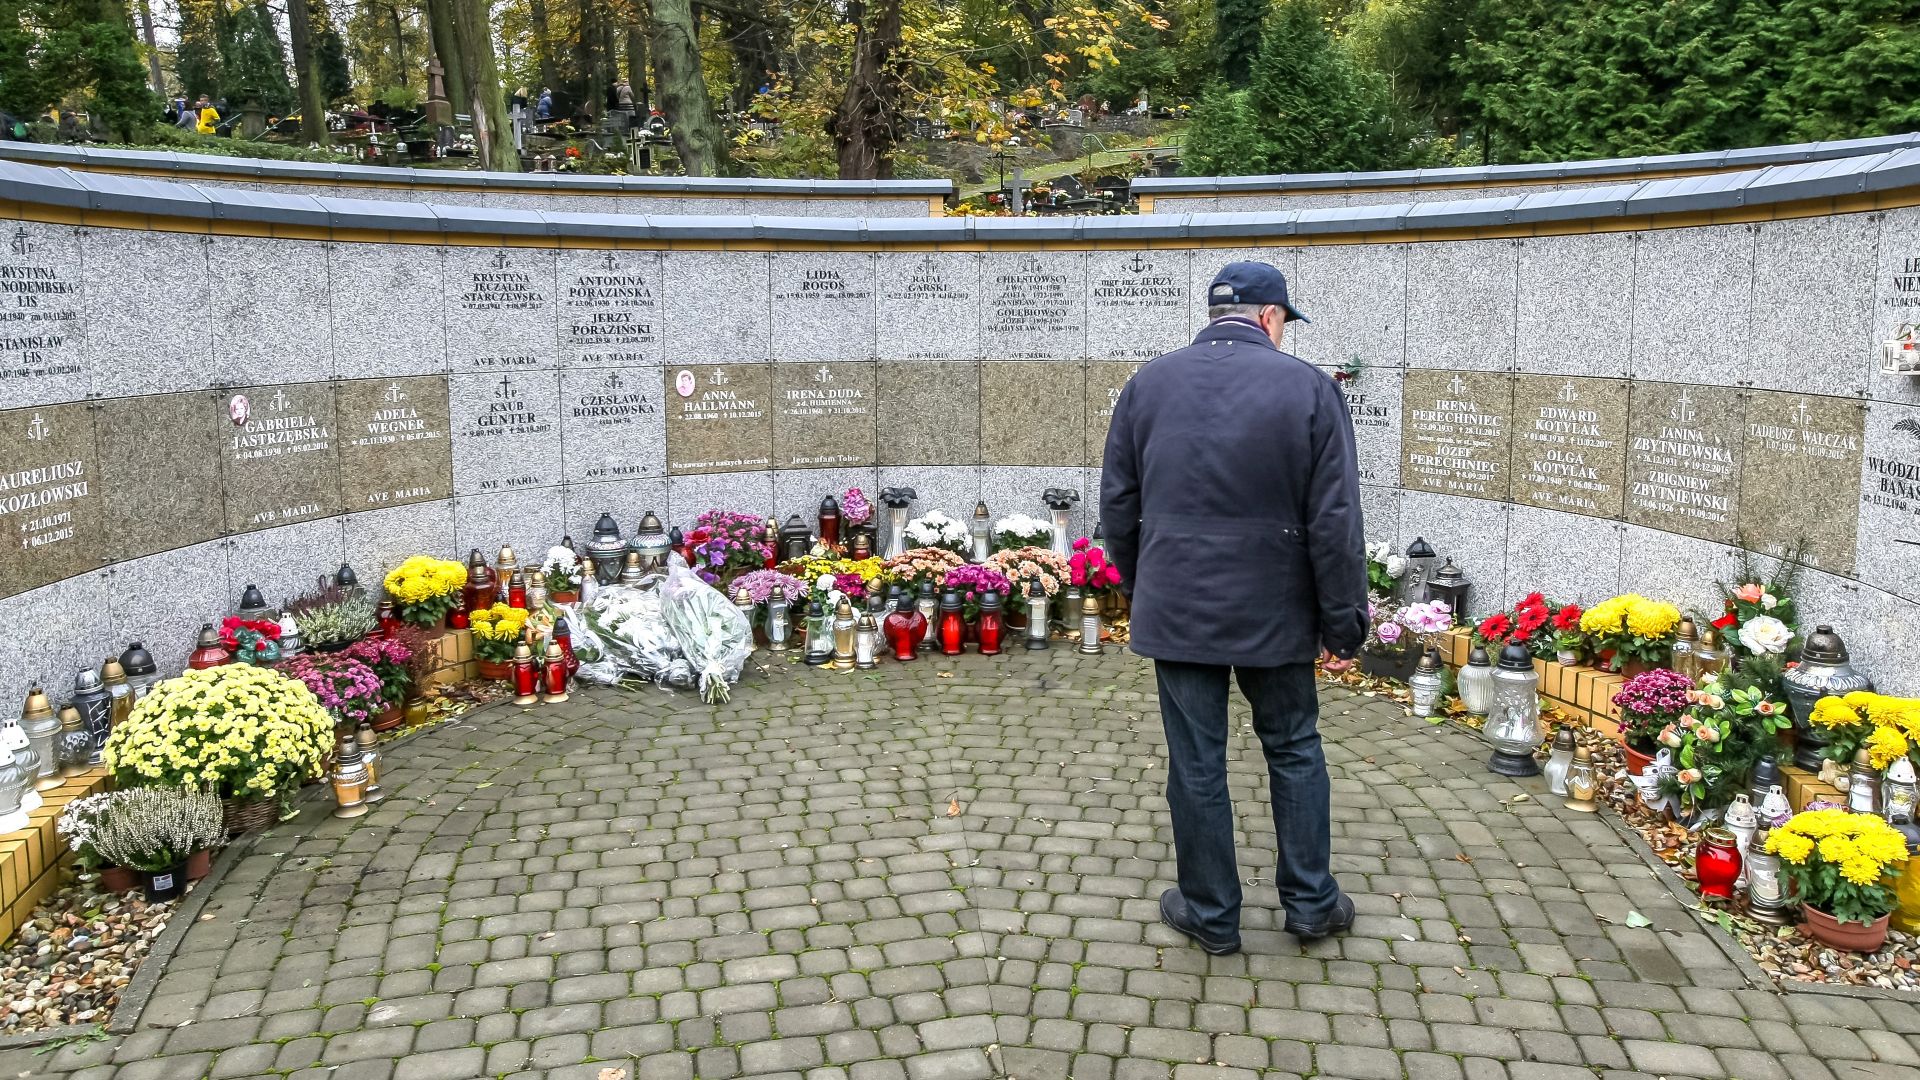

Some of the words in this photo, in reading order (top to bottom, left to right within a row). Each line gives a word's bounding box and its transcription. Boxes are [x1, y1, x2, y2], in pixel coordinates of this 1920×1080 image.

[0, 266, 56, 279] RYSTYNA
[473, 273, 530, 283] KRYSTYNA
[806, 270, 841, 280] LIDIA
[0, 281, 80, 294] NODEMBSKA-
[577, 276, 644, 286] ANTONINA
[1101, 279, 1118, 287] mgr
[1140, 277, 1174, 286] JERZY
[1893, 276, 1920, 292] NIE
[1094, 287, 1181, 297] KIERZKOWSKI
[18, 296, 37, 307] LIS
[591, 313, 632, 323] JERZY
[23, 351, 42, 363] LIS
[582, 354, 603, 362] AVE
[609, 353, 644, 361] MARIA
[1133, 349, 1163, 357] MARIA
[474, 358, 495, 366] AVE
[500, 356, 537, 366] MARIA
[702, 390, 737, 400] ANNA
[787, 389, 825, 399] IRENA
[828, 388, 862, 399] DUDA
[1344, 394, 1366, 404] ZEF
[490, 401, 524, 412] KAUB
[580, 395, 647, 407] CZESŁAWA
[684, 400, 756, 412] HALLMANN
[1436, 399, 1477, 412] IRENA
[374, 408, 418, 421] ADELA
[573, 405, 655, 417] BORKOWSKA
[1350, 405, 1388, 417] ELSKI
[1540, 407, 1597, 422] EDWARD
[245, 415, 316, 433] GABRIELA
[1412, 409, 1503, 427] PERECHINIEC
[367, 419, 425, 434] WEGNER
[1535, 420, 1600, 436] KOTYLAK
[232, 427, 329, 450] JASTRZĘBSKA
[1660, 426, 1704, 442] JANINA
[1750, 423, 1795, 441] TADEUSZ
[1802, 430, 1857, 451] WALCZAK
[1633, 436, 1733, 463] ZBYTNIEWSKA
[838, 454, 860, 462] Tobie
[1410, 453, 1500, 473] PERECHINIEC
[1547, 449, 1584, 465] OLGA
[0, 461, 84, 490] AURELIUSZ
[586, 469, 607, 477] AVE
[612, 465, 648, 475] MARIA
[1358, 470, 1376, 479] RIA
[1533, 460, 1598, 480] KOTYLAK
[480, 480, 499, 489] AVE
[506, 476, 539, 487] MARIA
[1422, 478, 1442, 487] AVE
[1448, 480, 1485, 492] MARIA
[1649, 470, 1712, 491] ZBIGNIEW
[0, 481, 88, 515] KOZŁOWSKI
[368, 492, 389, 503] AVE
[395, 487, 432, 499] MARIA
[1532, 491, 1553, 502] AVE
[1558, 495, 1596, 509] MARIA
[1632, 481, 1728, 511] ZBYTNIEWSKI
[253, 511, 276, 523] AVE
[282, 504, 320, 518] MARIA
[29, 511, 72, 531] 21.10.1971
[31, 527, 74, 547] 06.12.2015
[1767, 543, 1783, 557] AVE
[1788, 549, 1820, 567] MRIA
